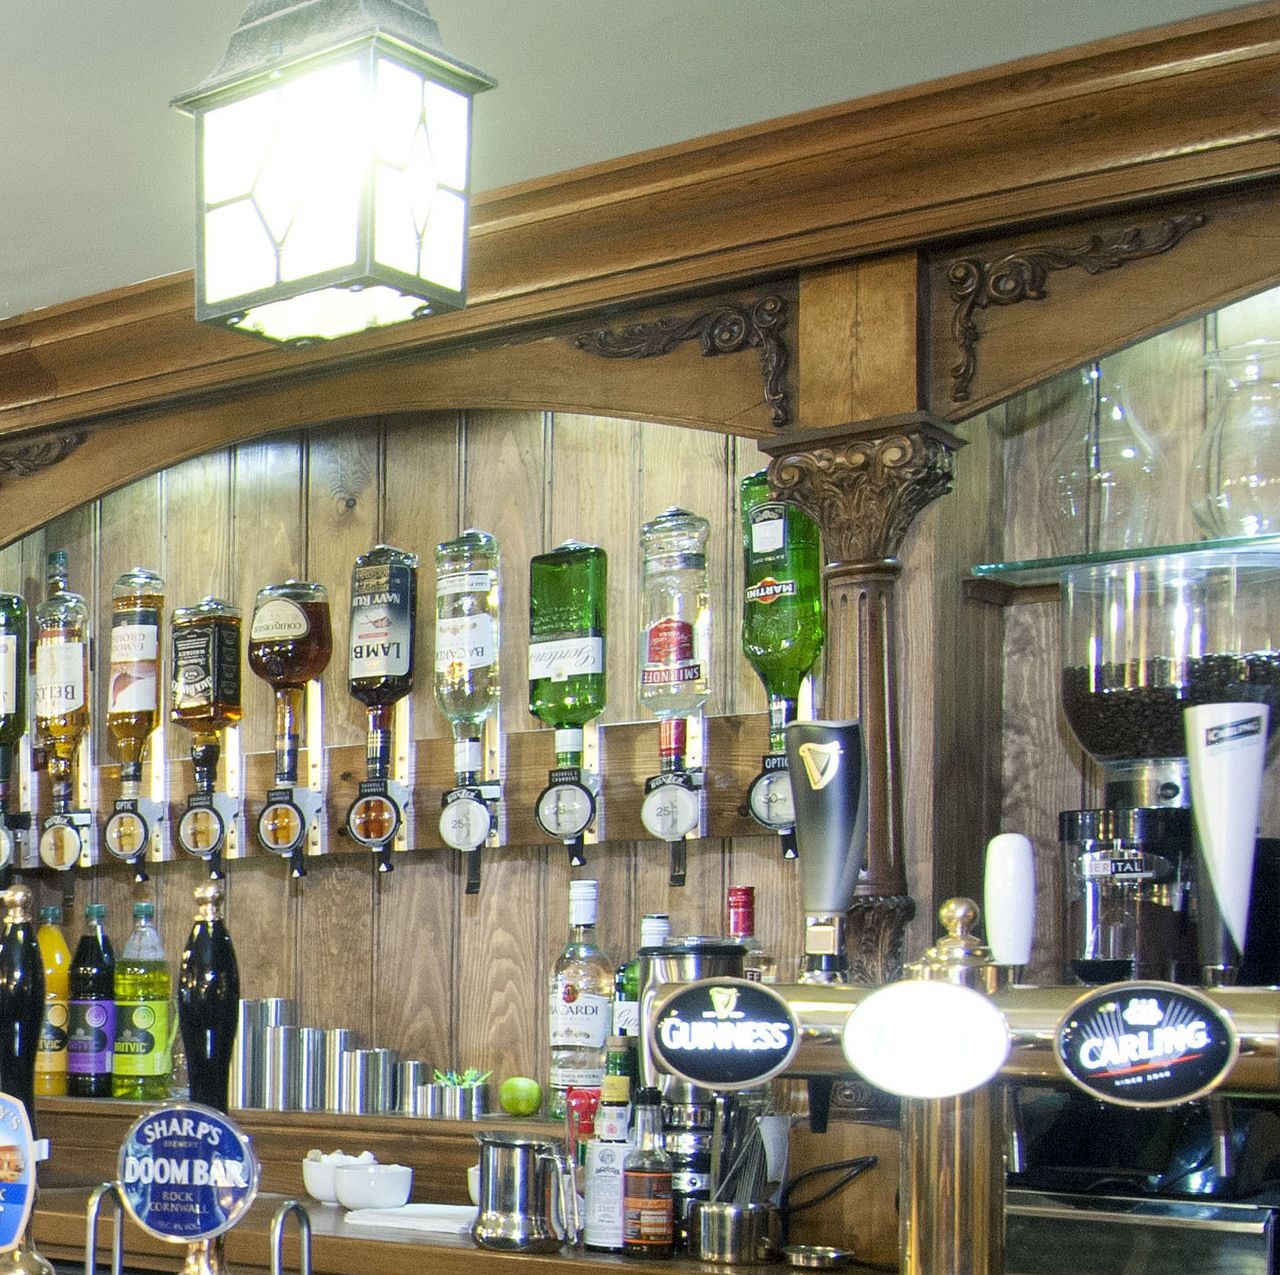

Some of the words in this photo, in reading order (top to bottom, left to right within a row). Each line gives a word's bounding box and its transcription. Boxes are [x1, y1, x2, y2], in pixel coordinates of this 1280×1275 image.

[373, 592, 401, 605] NAVY
[747, 582, 795, 599] MARTINI
[353, 642, 401, 659] LAMB
[437, 646, 485, 658] BACARD
[643, 666, 700, 683] SMIRNOFF
[549, 1004, 600, 1016] ACARDI
[660, 1017, 790, 1050] GUINNESS
[1079, 1021, 1210, 1069] CARLING
[143, 1118, 222, 1146] SHARP'S
[125, 1156, 190, 1184] DOOM
[192, 1159, 248, 1188] BAR
[162, 1191, 193, 1202] ROCK
[149, 1201, 209, 1214] CORNWALL
